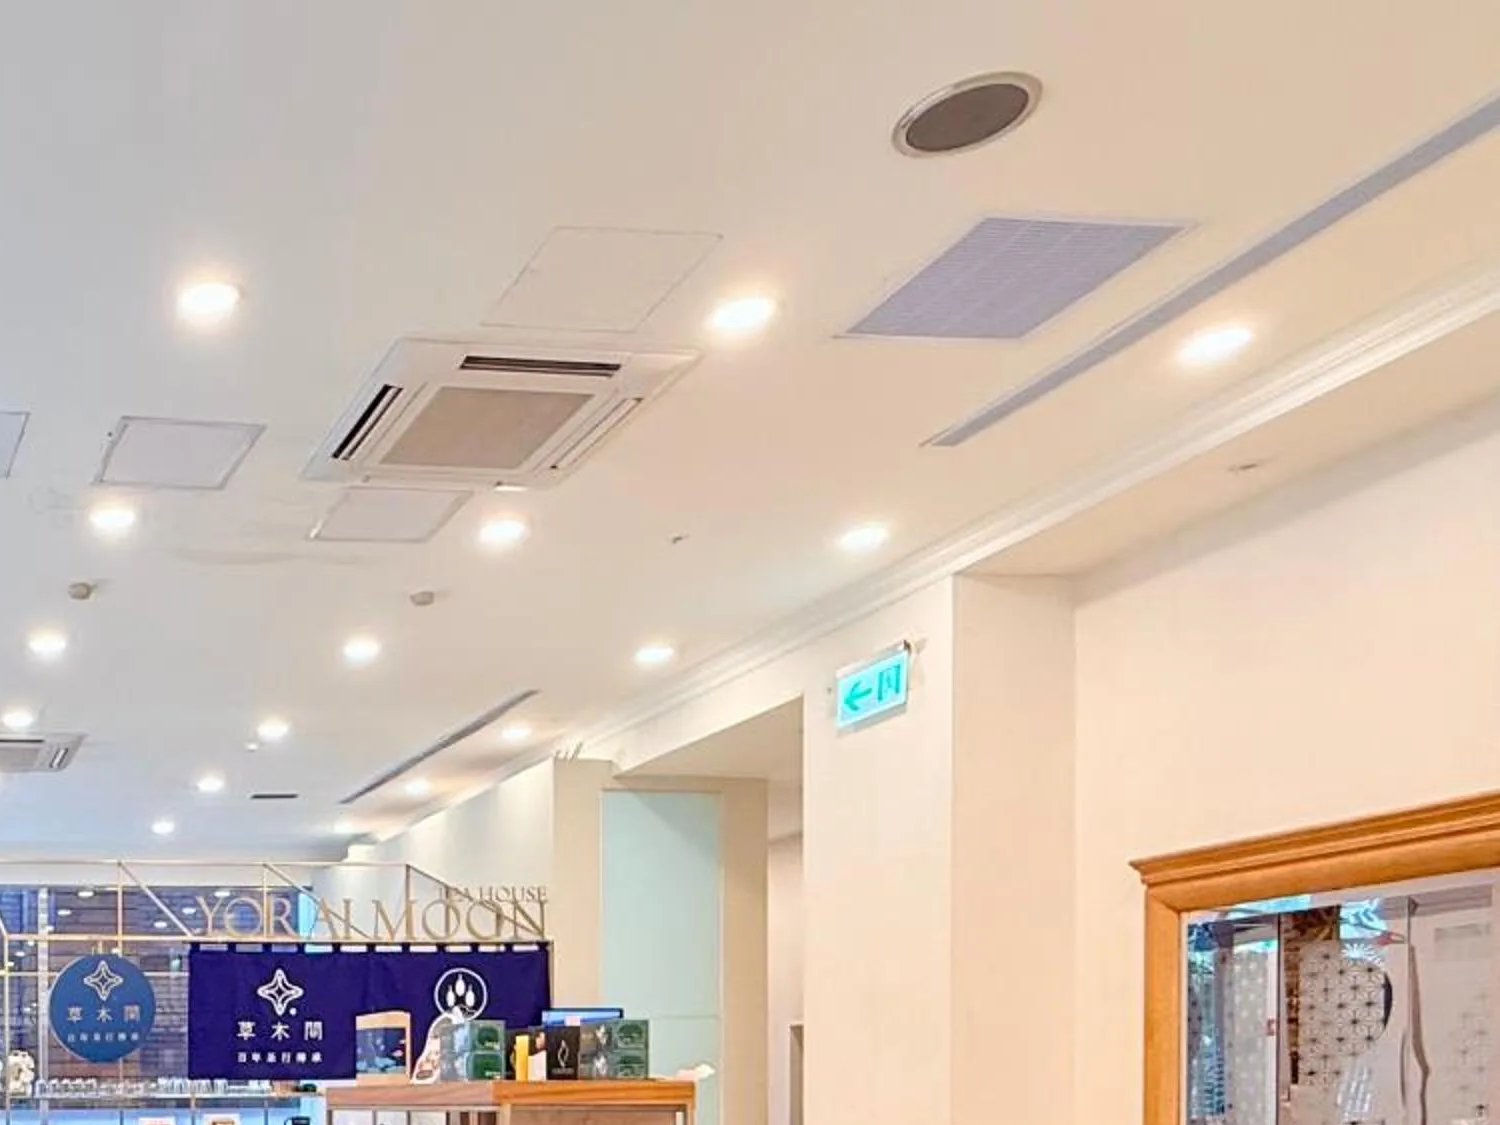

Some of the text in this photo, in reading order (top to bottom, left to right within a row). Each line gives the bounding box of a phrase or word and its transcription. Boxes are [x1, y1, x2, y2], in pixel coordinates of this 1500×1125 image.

[477, 885, 549, 903] HOUSE
[236, 1021, 323, 1041] 草木間
